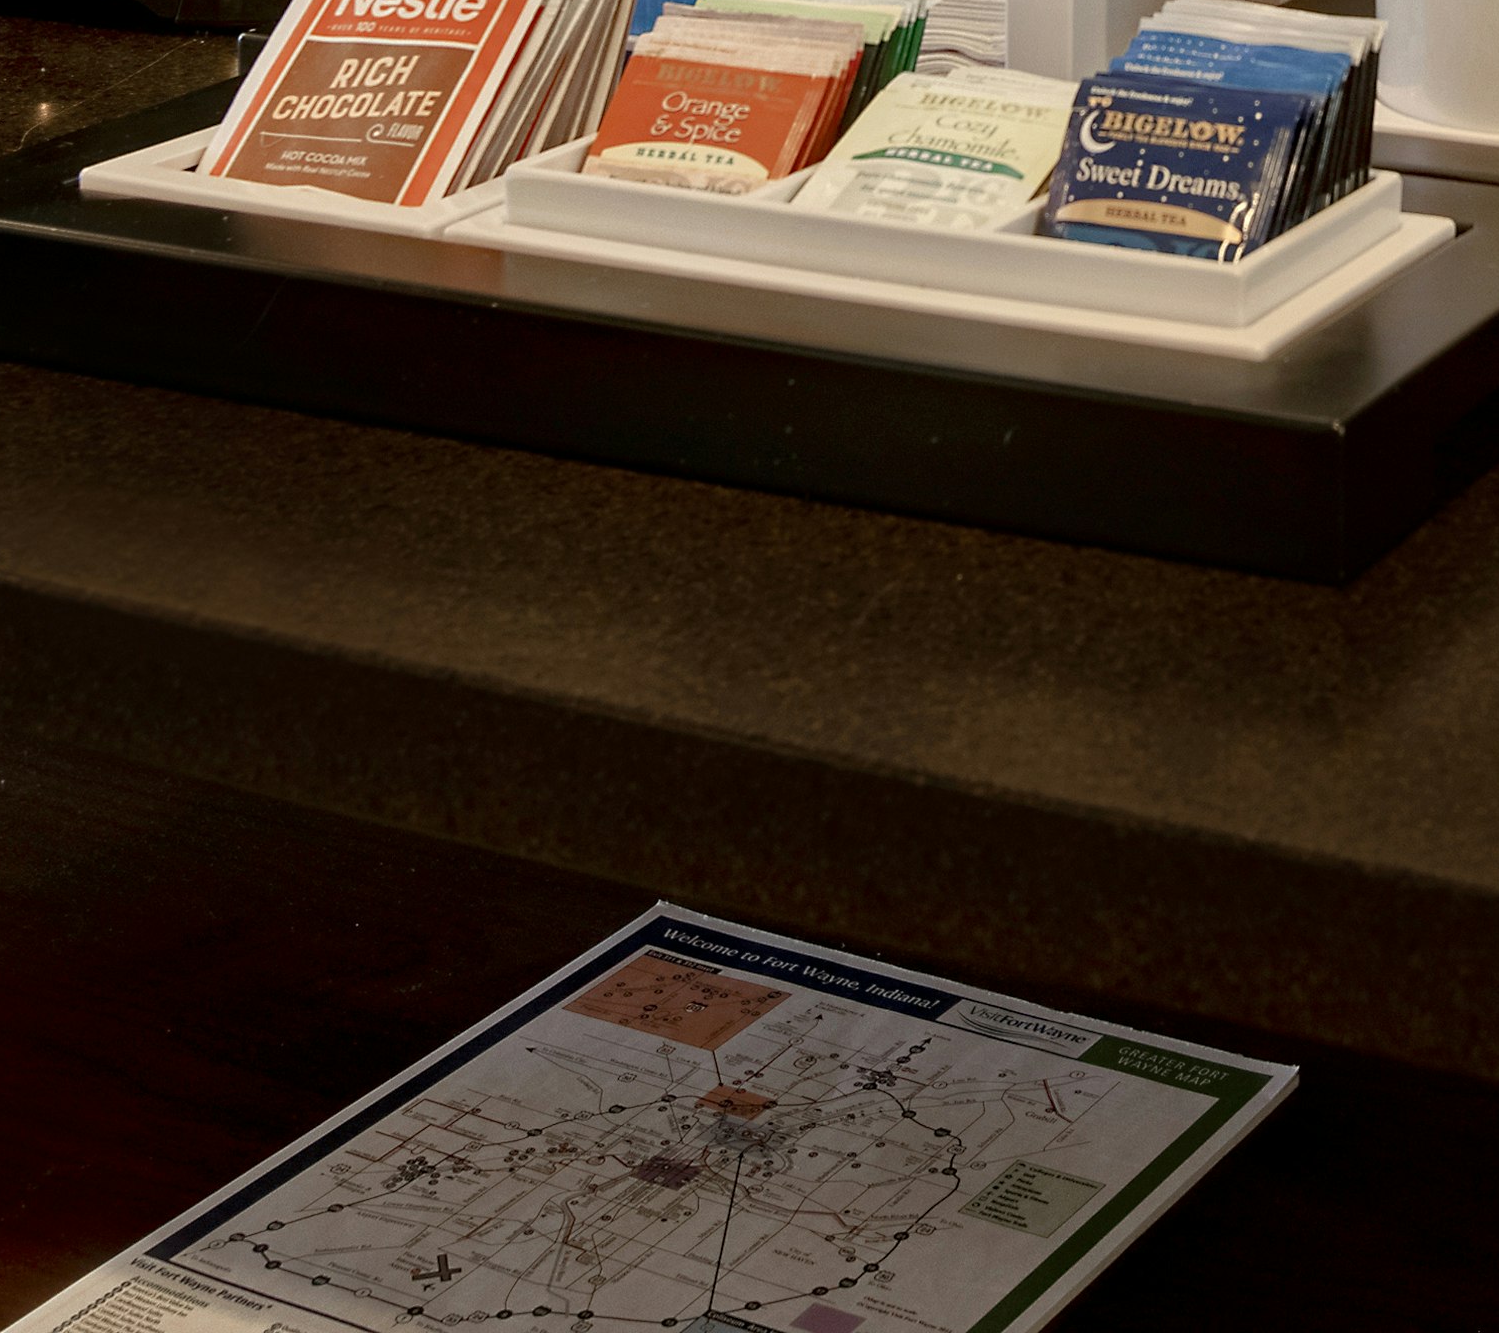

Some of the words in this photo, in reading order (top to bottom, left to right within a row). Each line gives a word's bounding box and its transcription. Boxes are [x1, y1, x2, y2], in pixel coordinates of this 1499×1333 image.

[356, 21, 376, 33] 100
[330, 55, 420, 90] RICH
[272, 90, 442, 121] CHOCOLATE
[661, 91, 751, 124] Orange
[386, 122, 424, 141] FLAVOR
[650, 112, 673, 137] &
[674, 117, 742, 143] Spice
[936, 114, 999, 140] Cozy
[280, 151, 305, 161] HOT
[305, 152, 346, 165] COCOA
[346, 156, 369, 166] MIX
[636, 148, 697, 162] HERBAL
[703, 153, 736, 166] TEA
[1076, 155, 1141, 188] Sweet
[1147, 164, 1241, 200] Dreams
[1104, 206, 1157, 223] HERBAL
[1162, 212, 1187, 227] TEA
[656, 927, 745, 957] Welcome
[737, 951, 763, 962] to
[759, 955, 802, 972] Fort
[793, 965, 868, 992] Wayne,
[862, 982, 941, 1009] Indiana!
[1113, 1056, 1173, 1077] WAYNE
[1174, 1072, 1212, 1087] MAP
[1116, 1045, 1188, 1069] GREATER
[1187, 1064, 1230, 1080] FORT
[1022, 1110, 1059, 1124] Grabill
[124, 1275, 217, 1308] Accommodations
[126, 1257, 160, 1271] Visit
[151, 1266, 185, 1280] Fort
[173, 1275, 222, 1295] Wayne
